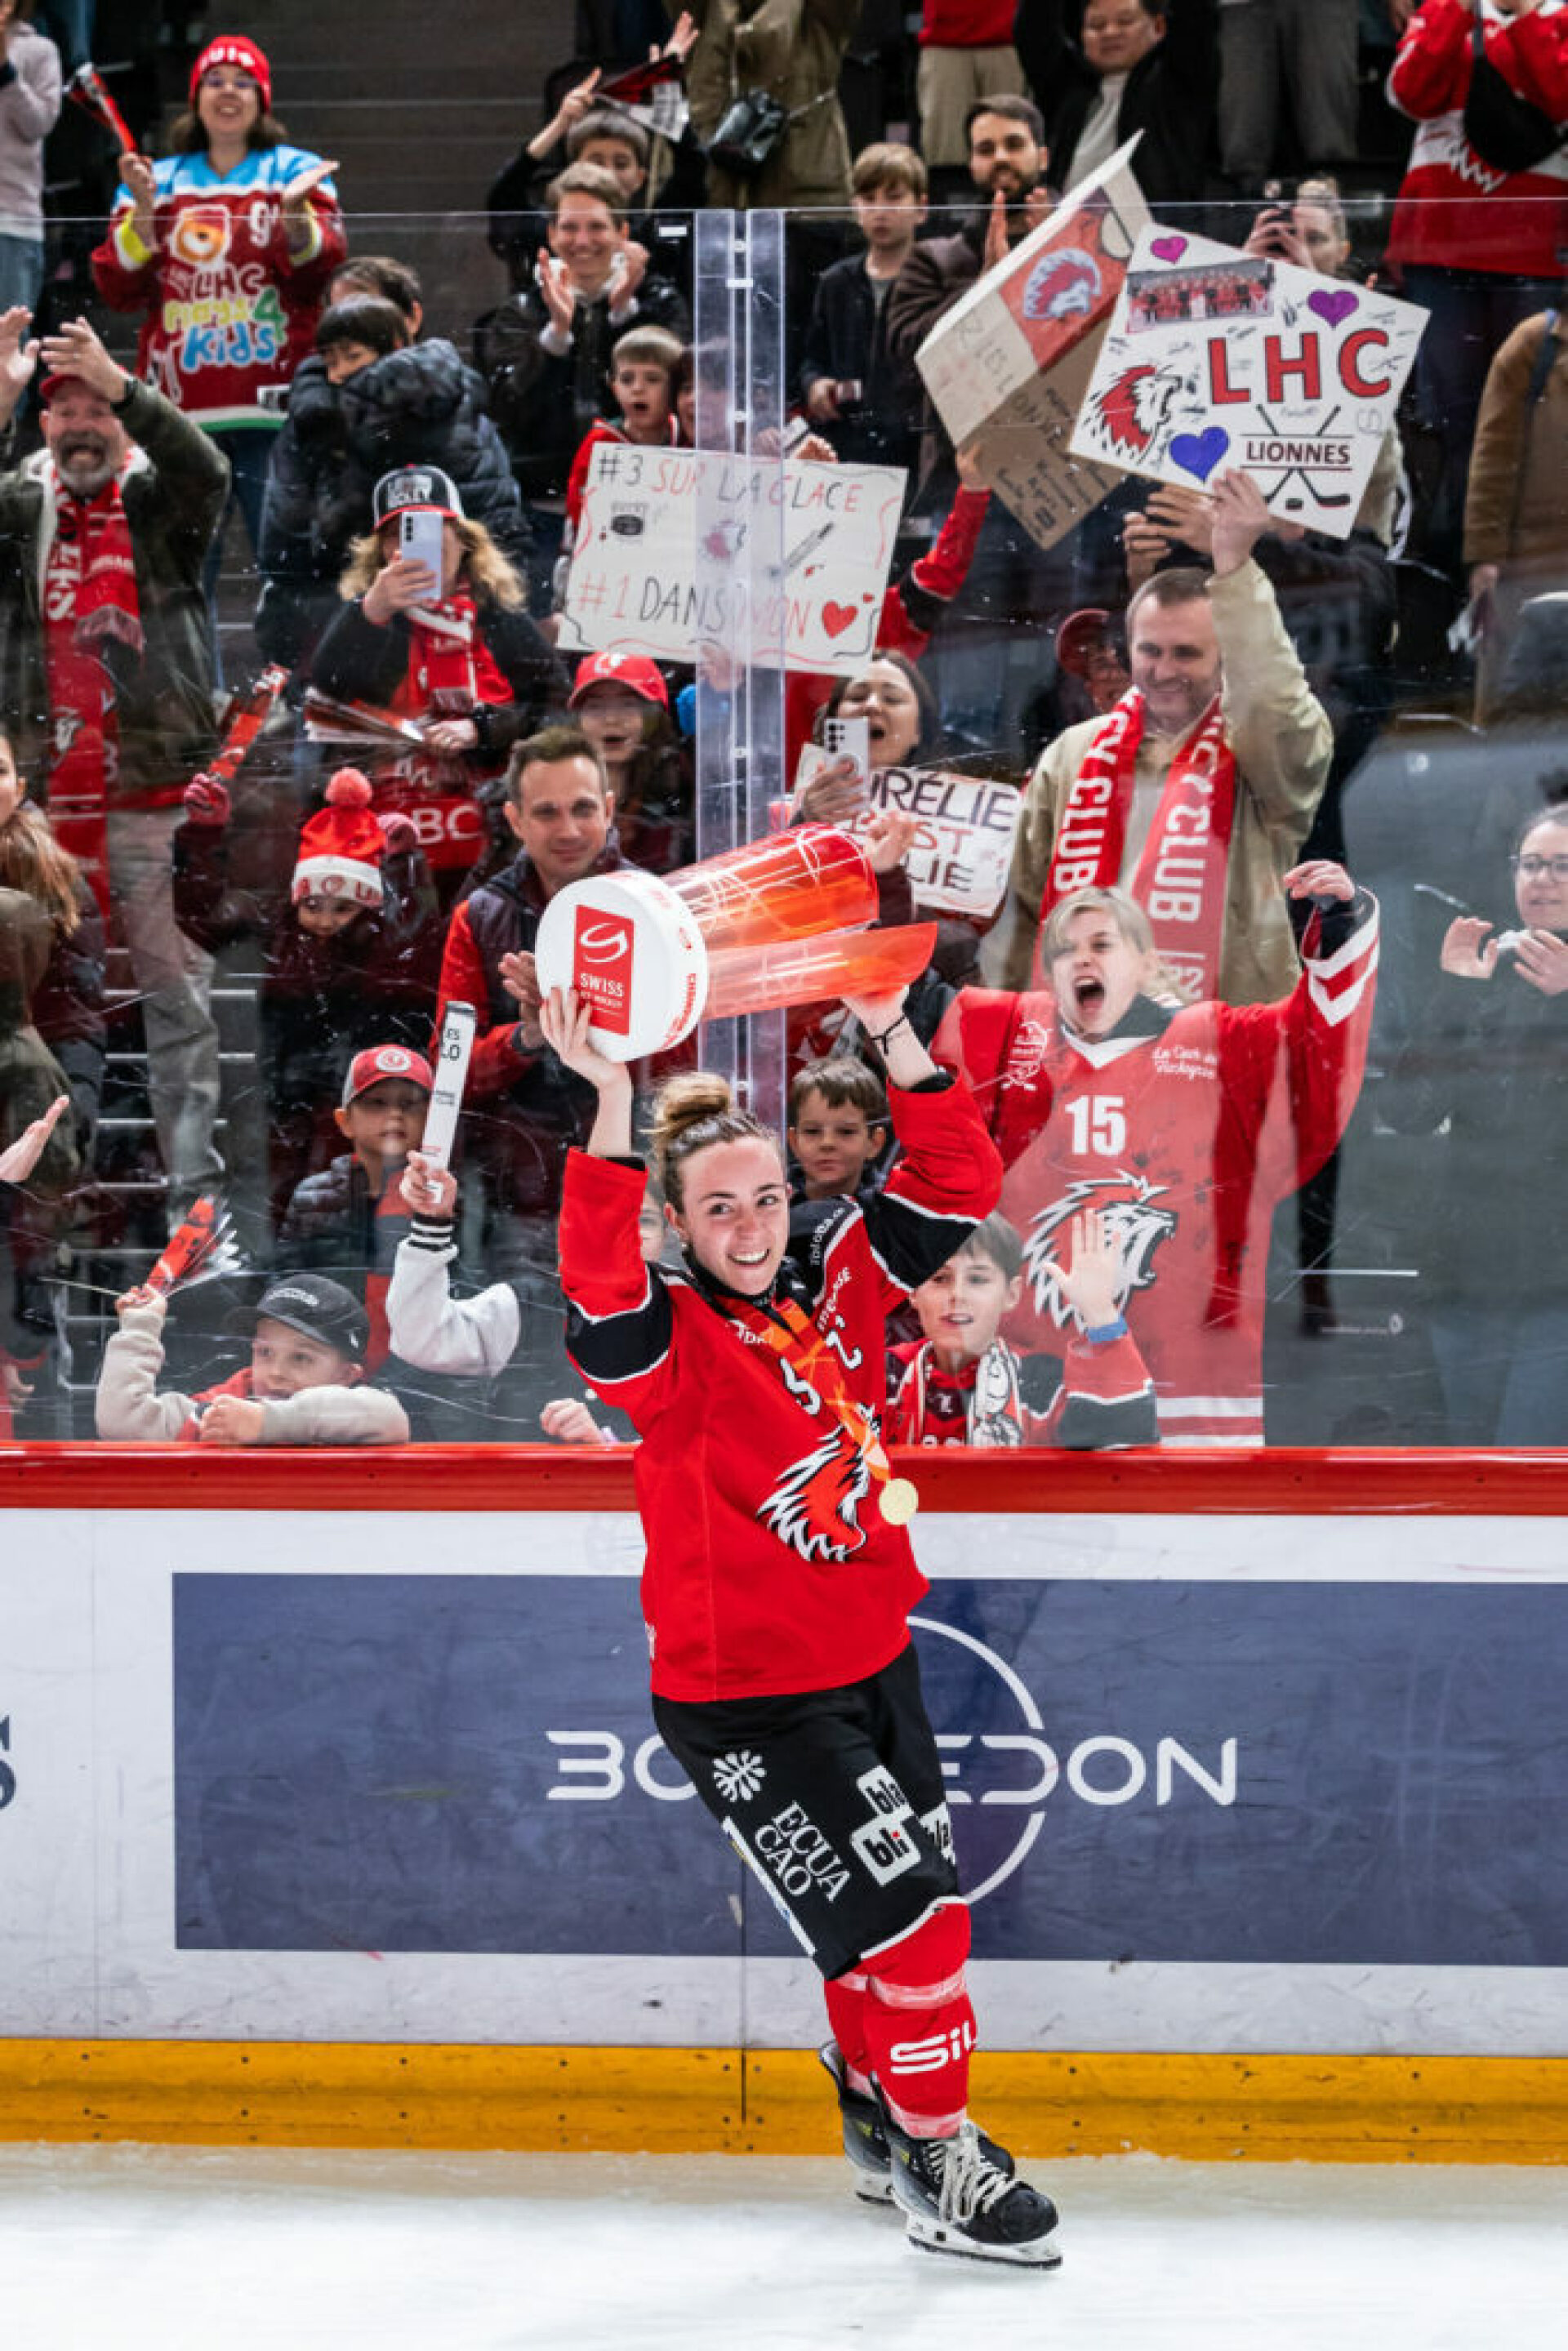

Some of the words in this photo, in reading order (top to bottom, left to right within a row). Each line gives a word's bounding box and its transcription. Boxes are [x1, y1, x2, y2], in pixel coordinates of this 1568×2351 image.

[252, 286, 289, 346] 4
[1208, 328, 1392, 404] LHC
[597, 450, 644, 486] #3
[653, 459, 708, 496] SUR
[1246, 440, 1351, 465] LIONNES
[577, 570, 630, 619] #1
[639, 576, 726, 632] DANS
[871, 768, 1018, 831] RÉLIE
[1053, 779, 1113, 893] CLUB
[1149, 804, 1211, 924] CLUB
[581, 973, 624, 997] SWISS
[1065, 1095, 1127, 1156] 15
[546, 1730, 1238, 1807] BOEDON
[755, 1823, 812, 1896] CAO
[773, 1801, 851, 1904] ECUA
[862, 1828, 911, 1868] bli
[890, 2019, 977, 2074] Sil
